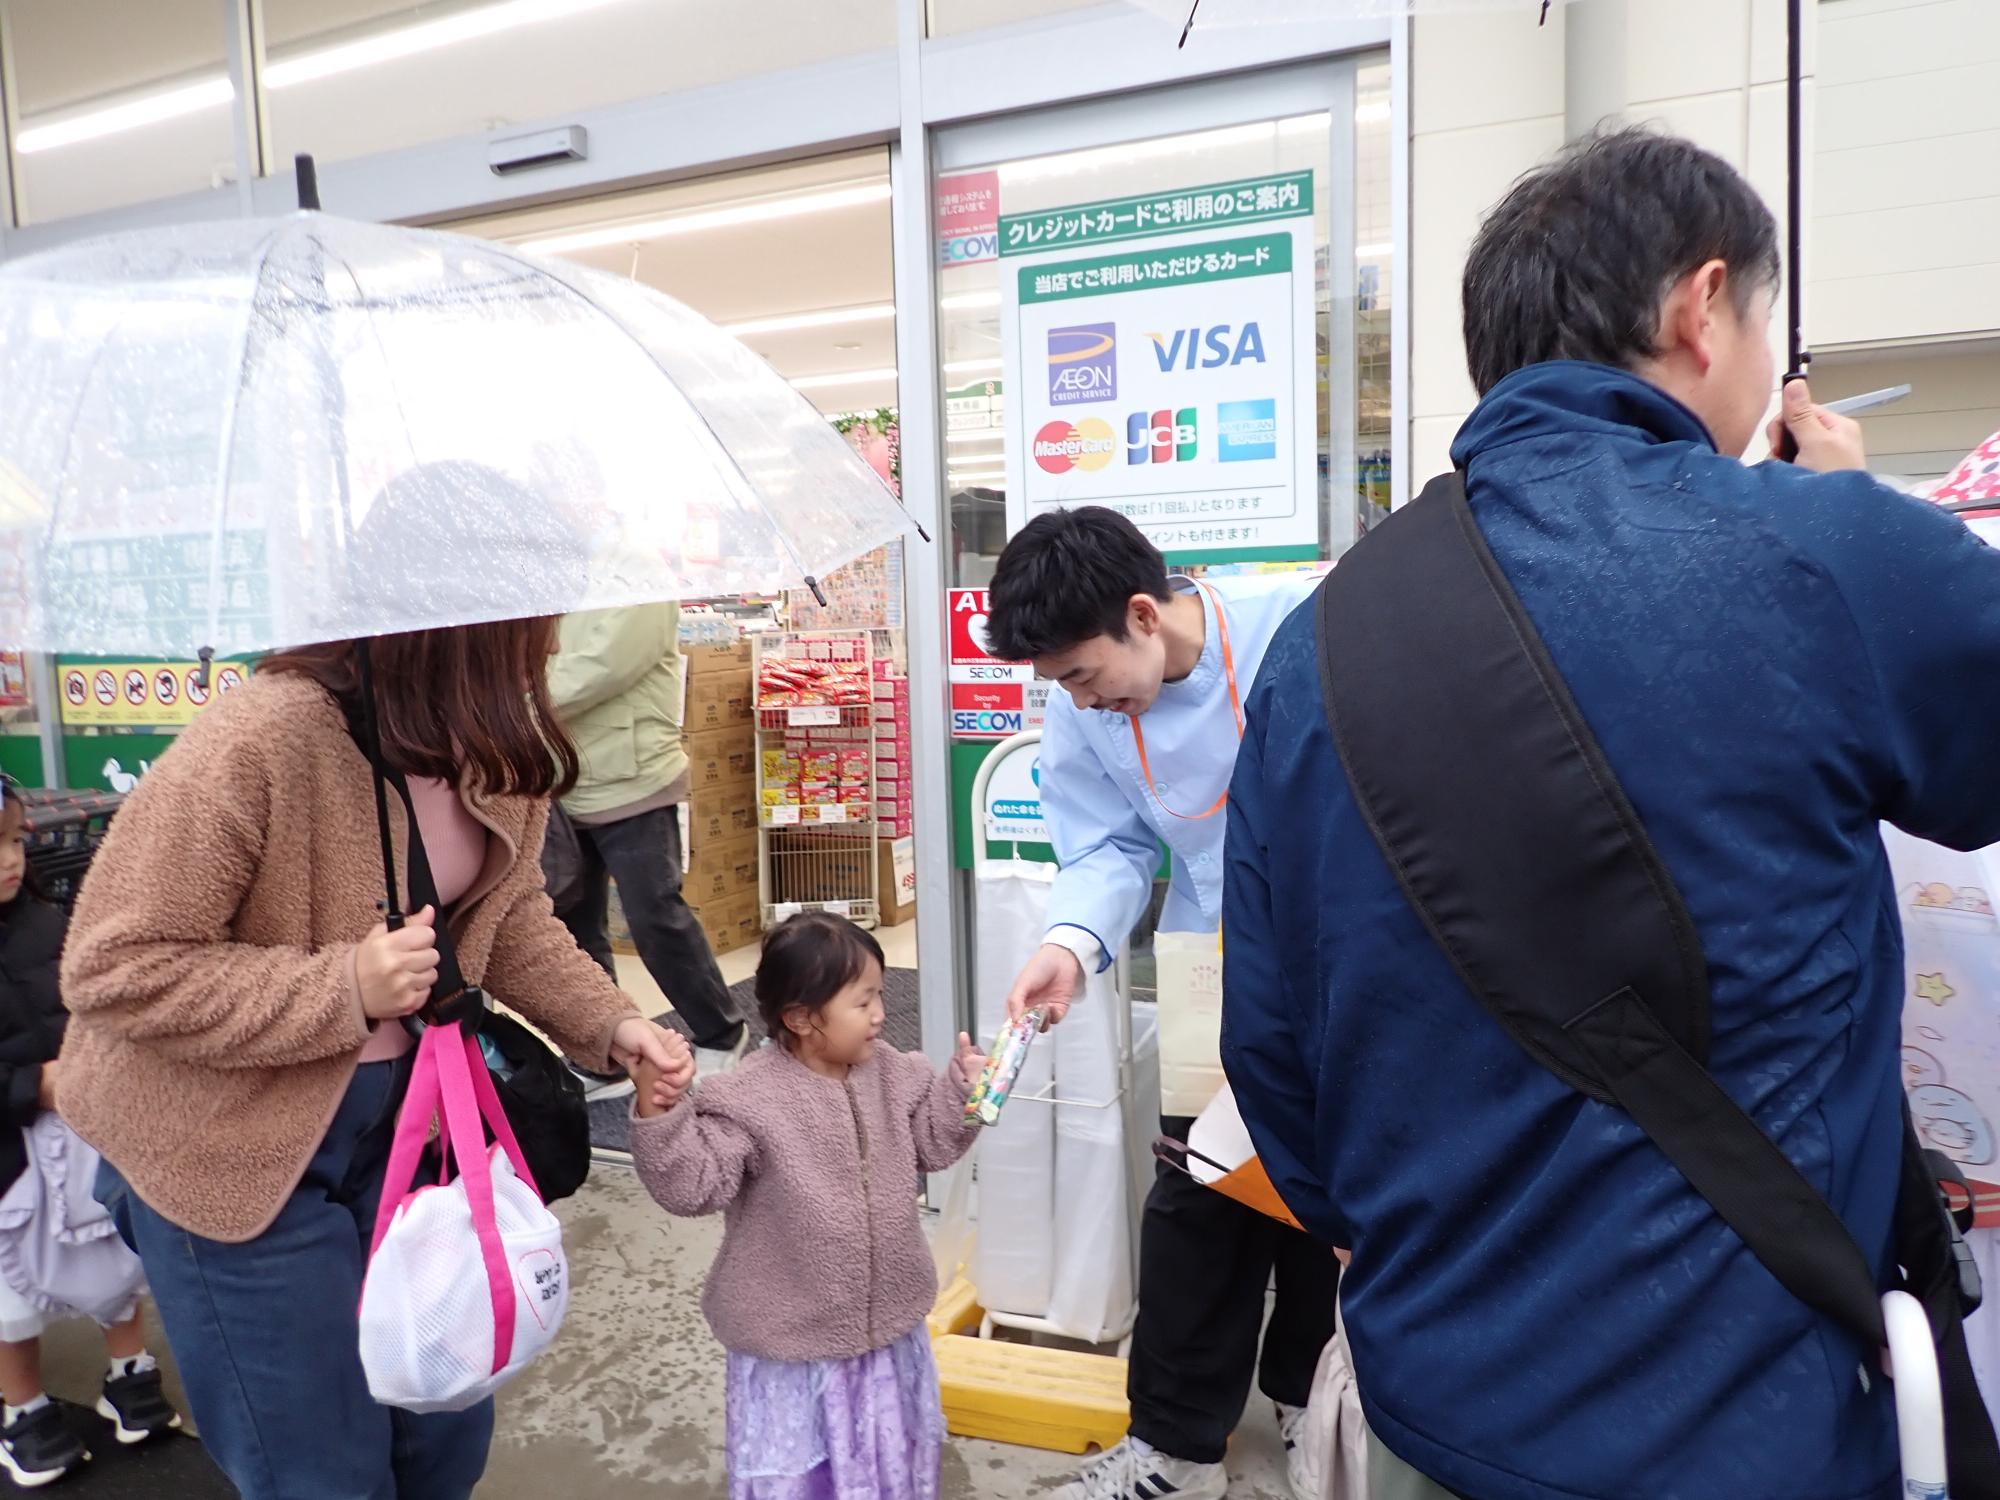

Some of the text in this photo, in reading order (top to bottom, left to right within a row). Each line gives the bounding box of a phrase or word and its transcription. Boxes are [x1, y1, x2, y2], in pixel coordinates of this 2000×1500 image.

[1008, 182, 1300, 247] クレジットカードご利用のご案内
[942, 236, 997, 261] ECOM
[1034, 246, 1270, 295] 当店でご利用いただけるカード
[1143, 321, 1267, 373] VISA
[1052, 388, 1112, 402] CREDIT SERVICE
[1126, 424, 1197, 450] JCB
[1218, 419, 1273, 434] AMERICAN
[1229, 431, 1277, 445] EXPRESS
[1034, 434, 1114, 459] MasterCard
[969, 667, 1013, 679] SECOM
[954, 712, 1021, 731] SECOM
